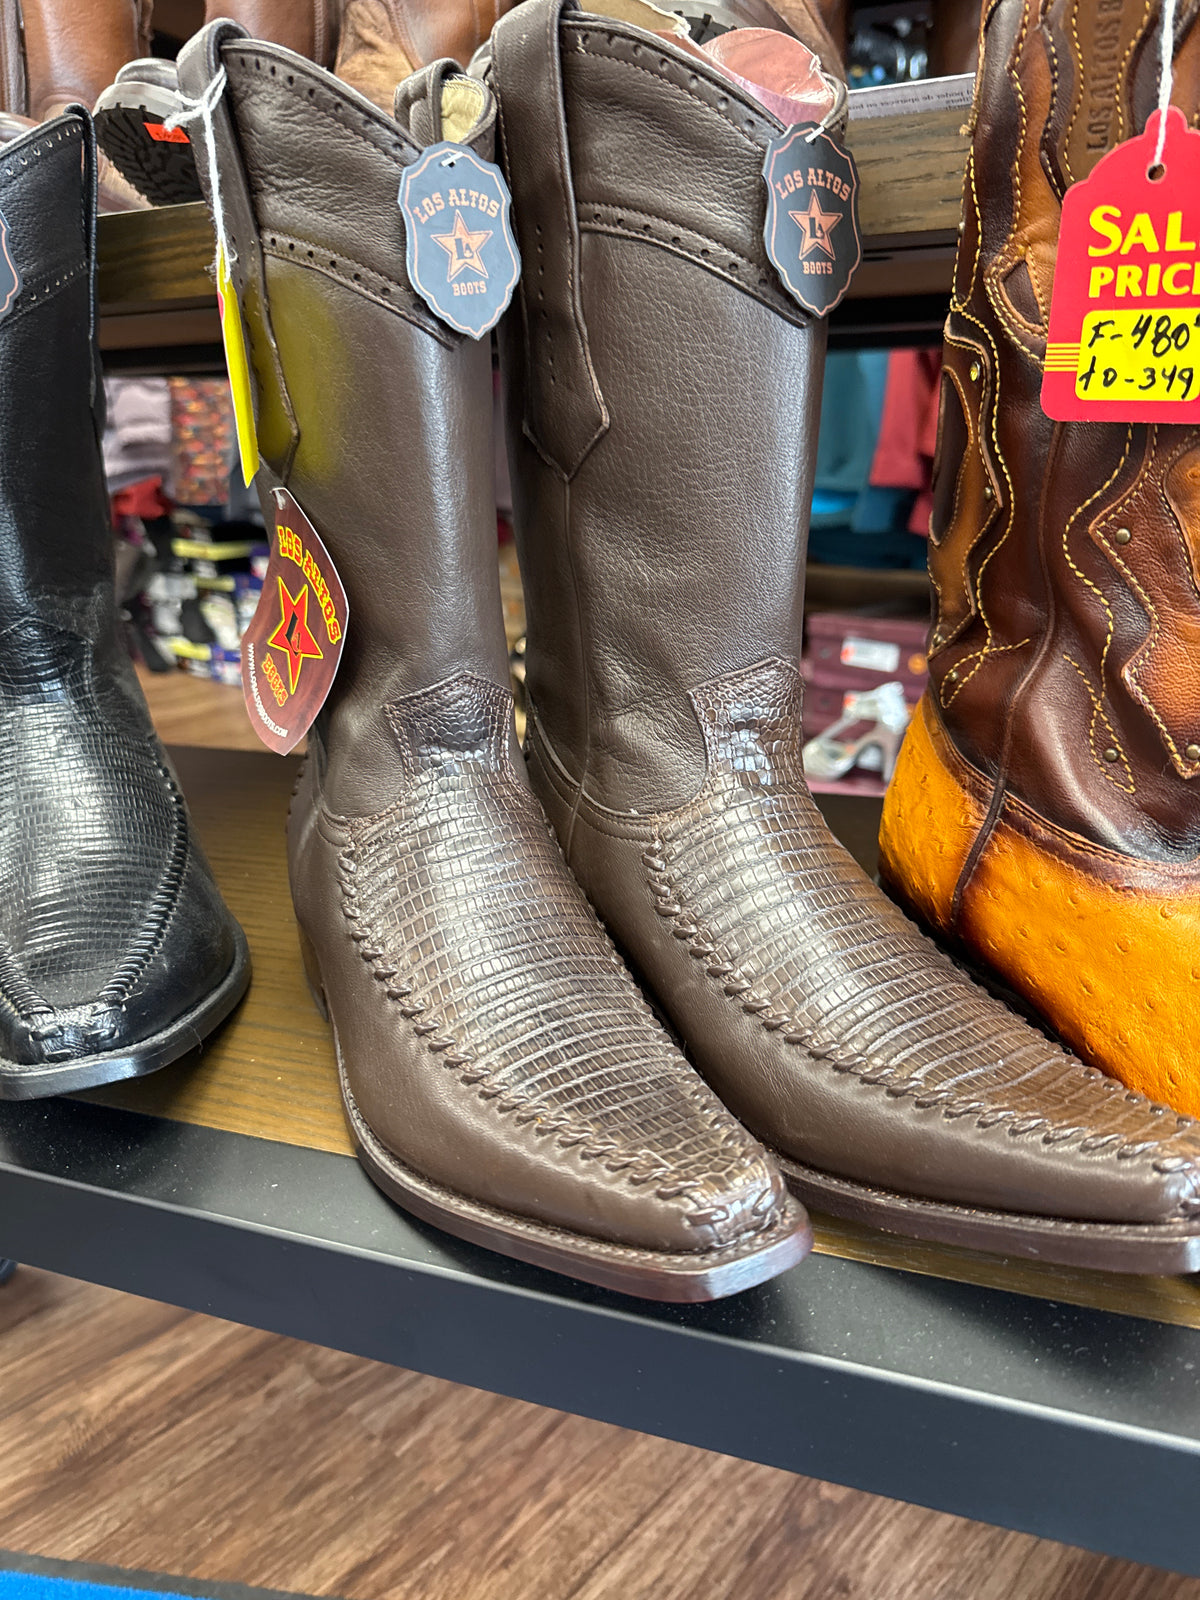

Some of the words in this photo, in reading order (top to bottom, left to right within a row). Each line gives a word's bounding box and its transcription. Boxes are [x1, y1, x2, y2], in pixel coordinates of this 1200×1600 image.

[1090, 19, 1121, 99] ALTOS
[1086, 107, 1113, 150] LOS
[774, 169, 804, 201] LOS
[807, 167, 851, 202] ALTOS
[413, 192, 445, 225] LOS
[448, 188, 500, 218] ALTOS
[1088, 204, 1200, 258] SAL
[452, 280, 488, 297] BOOTS
[802, 260, 834, 275] BOOTS
[277, 525, 304, 568] LOS
[302, 548, 343, 645] ALTOS
[261, 652, 289, 707] BOOTS
